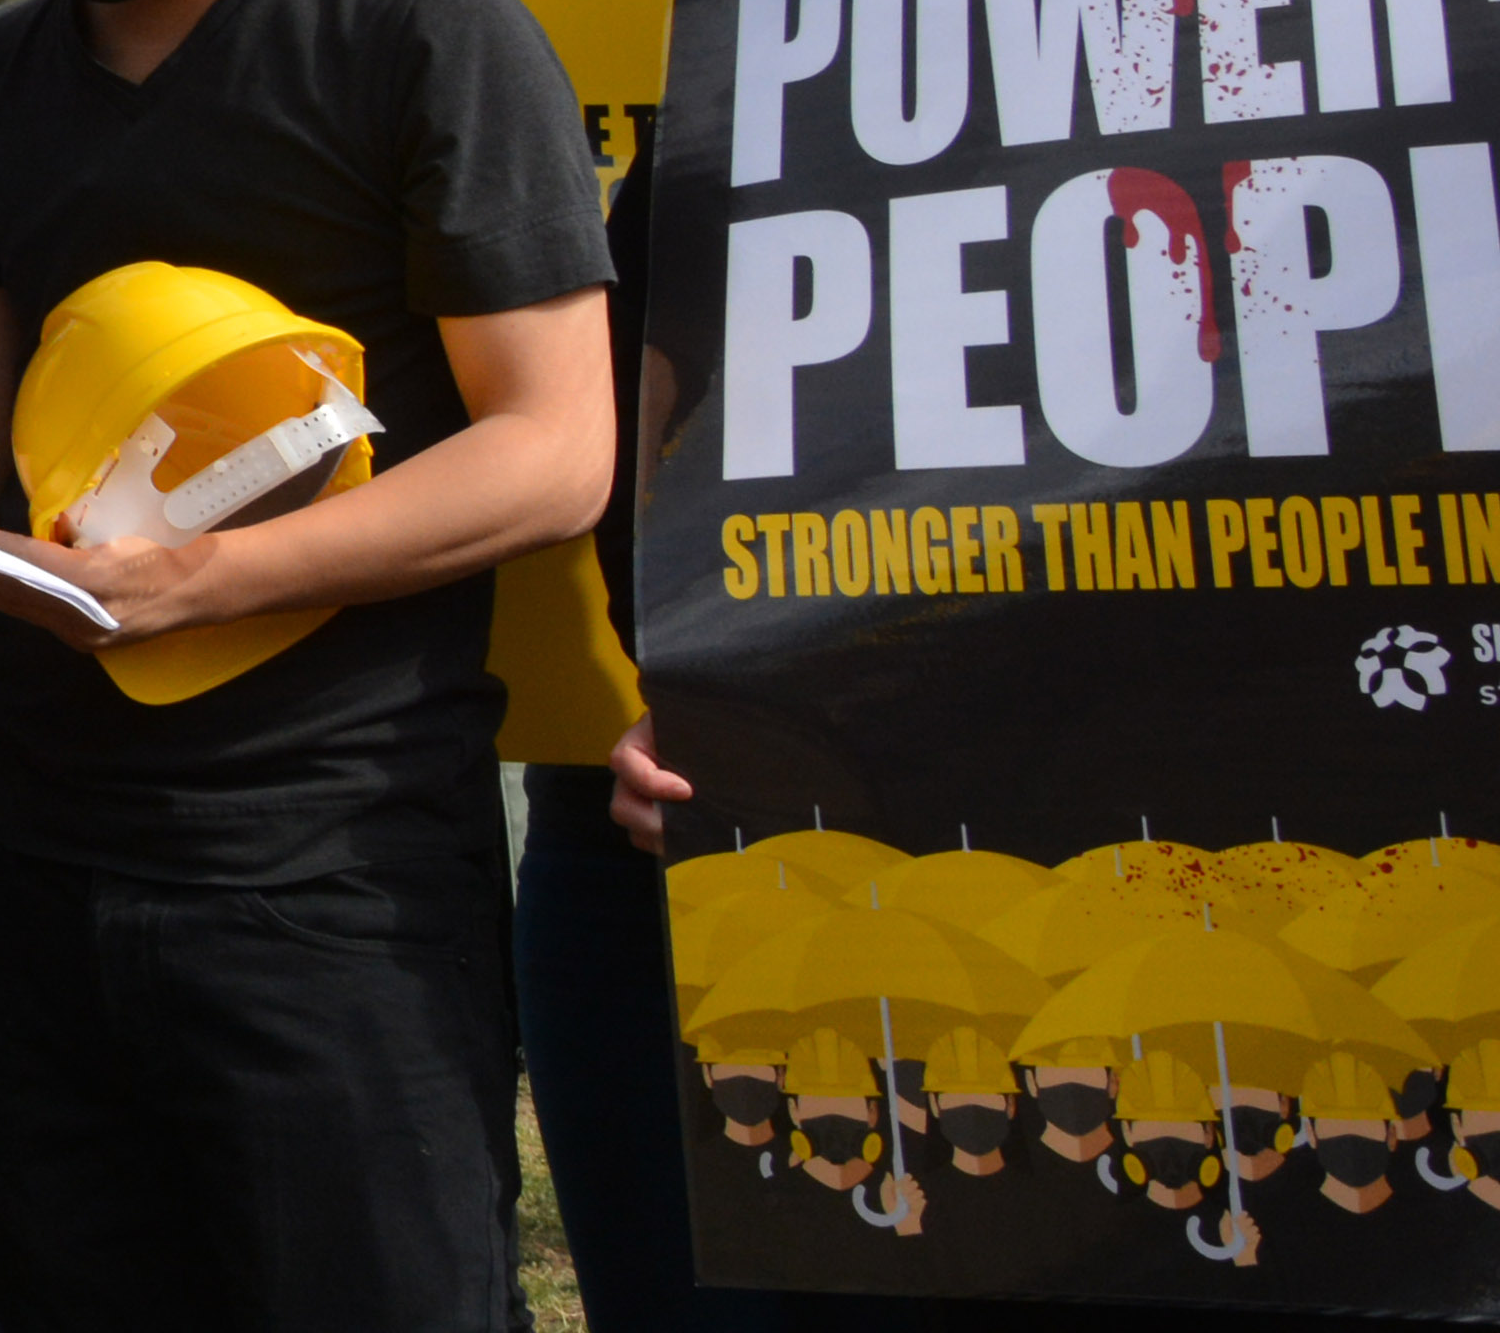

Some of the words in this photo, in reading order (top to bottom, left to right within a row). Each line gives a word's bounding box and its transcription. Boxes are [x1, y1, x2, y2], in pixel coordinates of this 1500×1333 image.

[722, 505, 1024, 599] STRONGER
[1032, 500, 1197, 592] THAN
[1210, 494, 1431, 588] PEOPLE
[1438, 493, 1500, 584] IN
